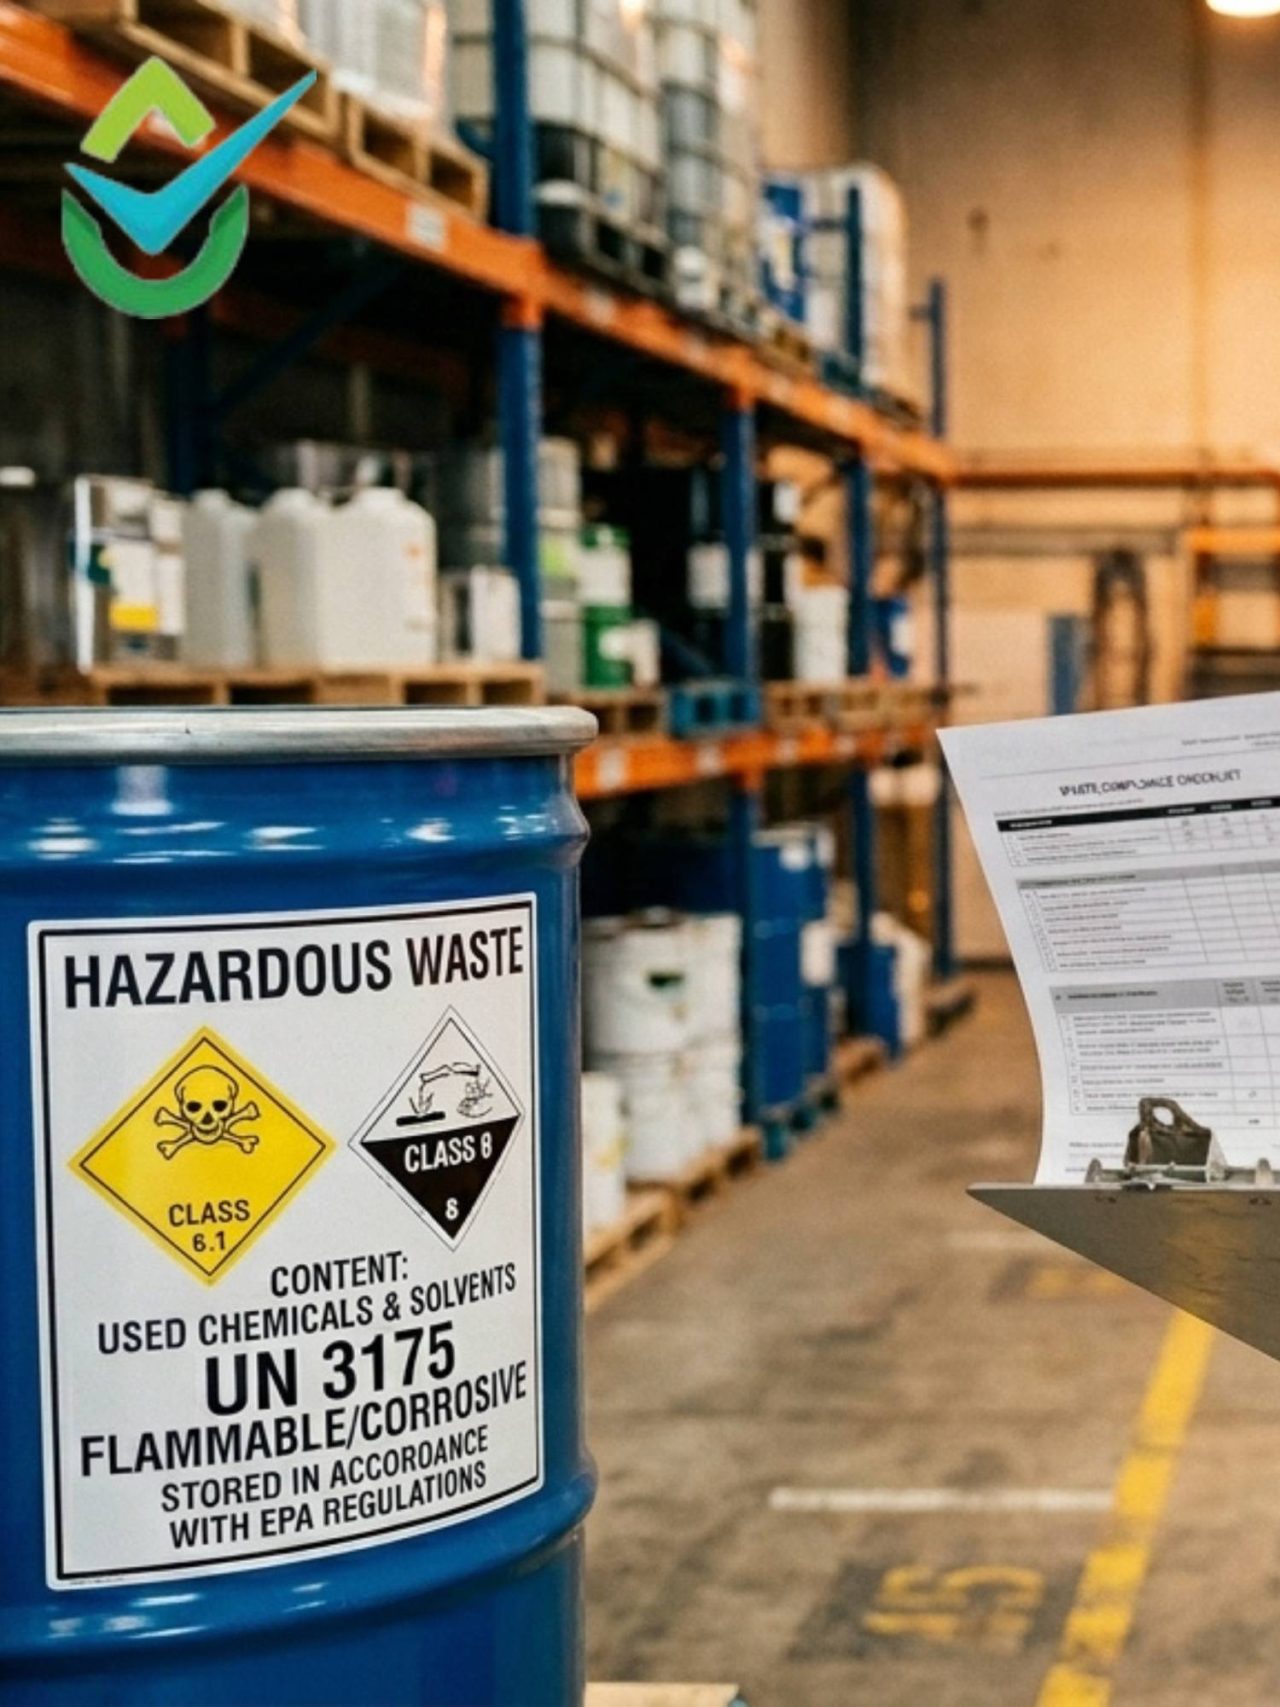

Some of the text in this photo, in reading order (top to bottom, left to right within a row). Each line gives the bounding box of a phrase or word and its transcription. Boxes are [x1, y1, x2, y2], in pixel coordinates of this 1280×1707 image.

[64, 925, 524, 1009] HAZARDOUS WASTE
[404, 1131, 493, 1173] CLASS 8
[168, 1199, 251, 1228] CLASS
[445, 1197, 459, 1221] 8
[191, 1230, 226, 1253] 6.1
[270, 1250, 409, 1297] CONTENT:
[98, 1262, 516, 1355] USED CHEMICALS & SOLVENTS
[205, 1320, 456, 1416] UN 3175
[80, 1360, 527, 1478] FLAMMABLE/CORROSIVE
[161, 1471, 282, 1513] STORED
[292, 1463, 320, 1496] IN
[169, 1459, 487, 1549] WITH EPA REGULATIONS
